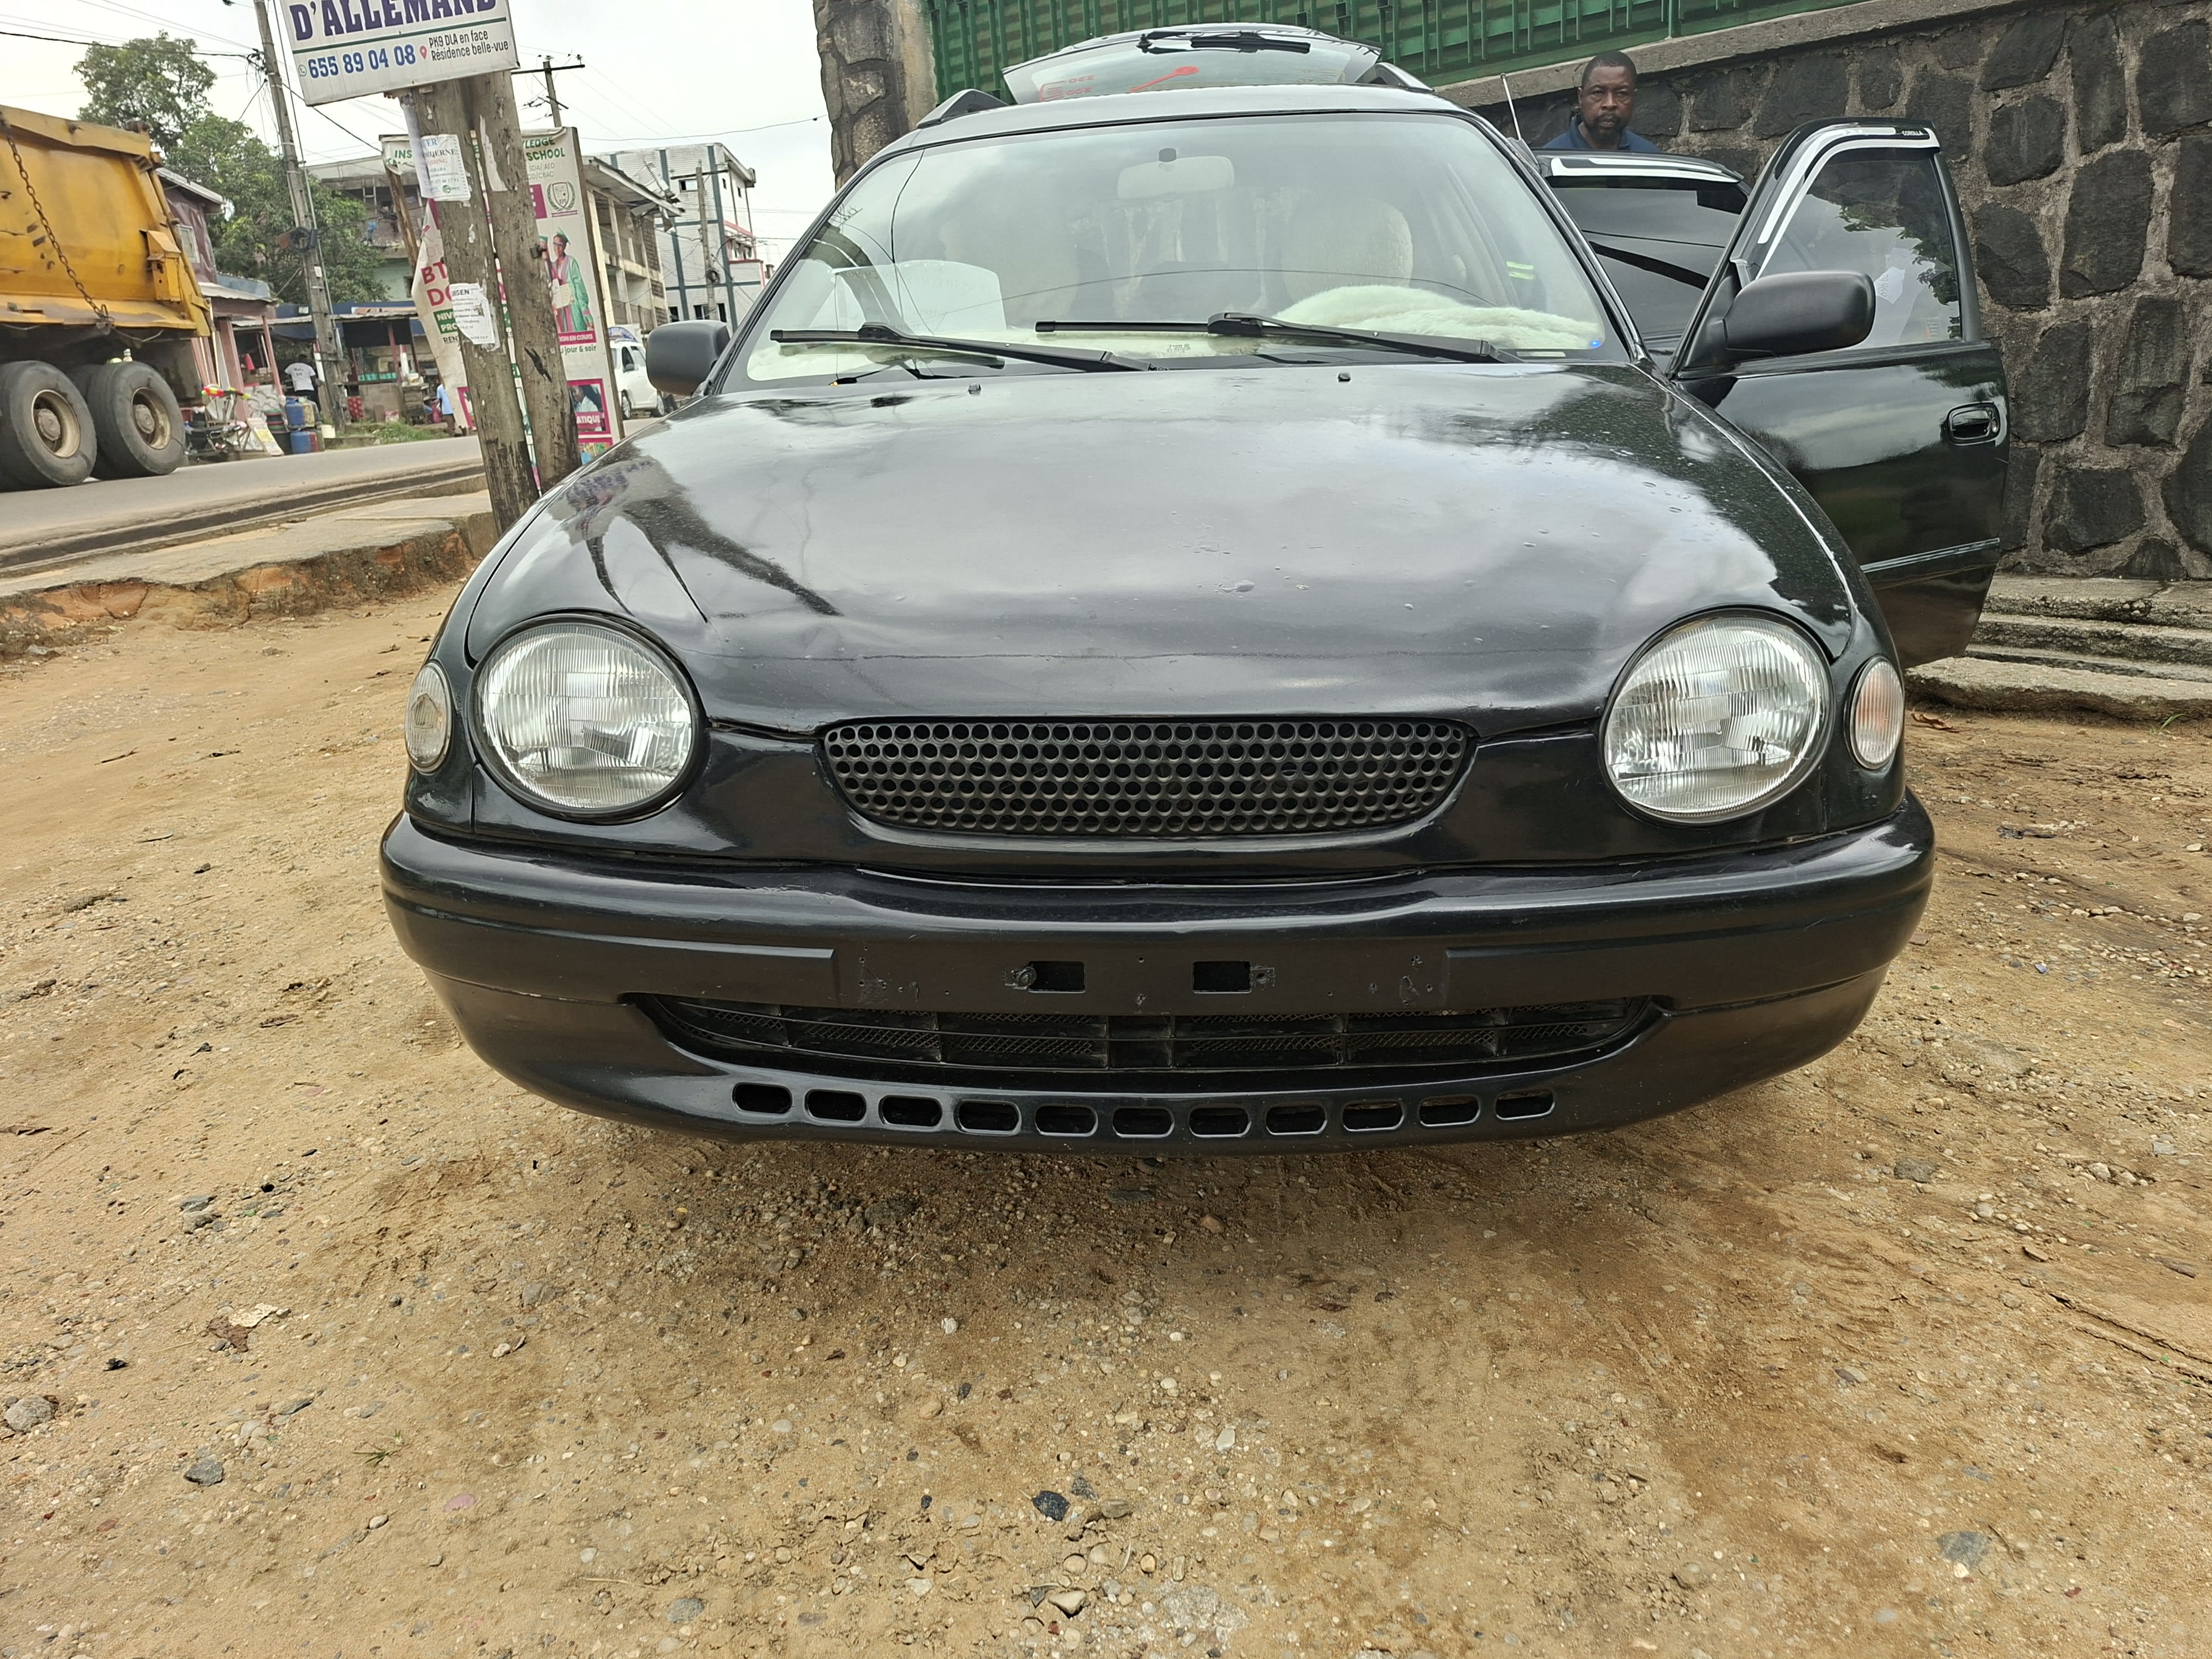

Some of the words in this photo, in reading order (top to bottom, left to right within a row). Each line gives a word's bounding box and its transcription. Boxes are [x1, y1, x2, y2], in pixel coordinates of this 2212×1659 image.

[429, 36, 444, 48] PK9
[445, 33, 458, 45] DLA
[460, 33, 469, 43] en
[471, 30, 488, 41] face
[431, 46, 470, 61] Résidence
[472, 40, 509, 55] belle-vue
[308, 56, 338, 79] 655
[342, 52, 364, 74] 89
[368, 48, 389, 70] 04
[394, 44, 416, 66] 08
[523, 137, 555, 148] LEDGE
[526, 148, 565, 161] SCHOOL
[564, 346, 577, 356] jour
